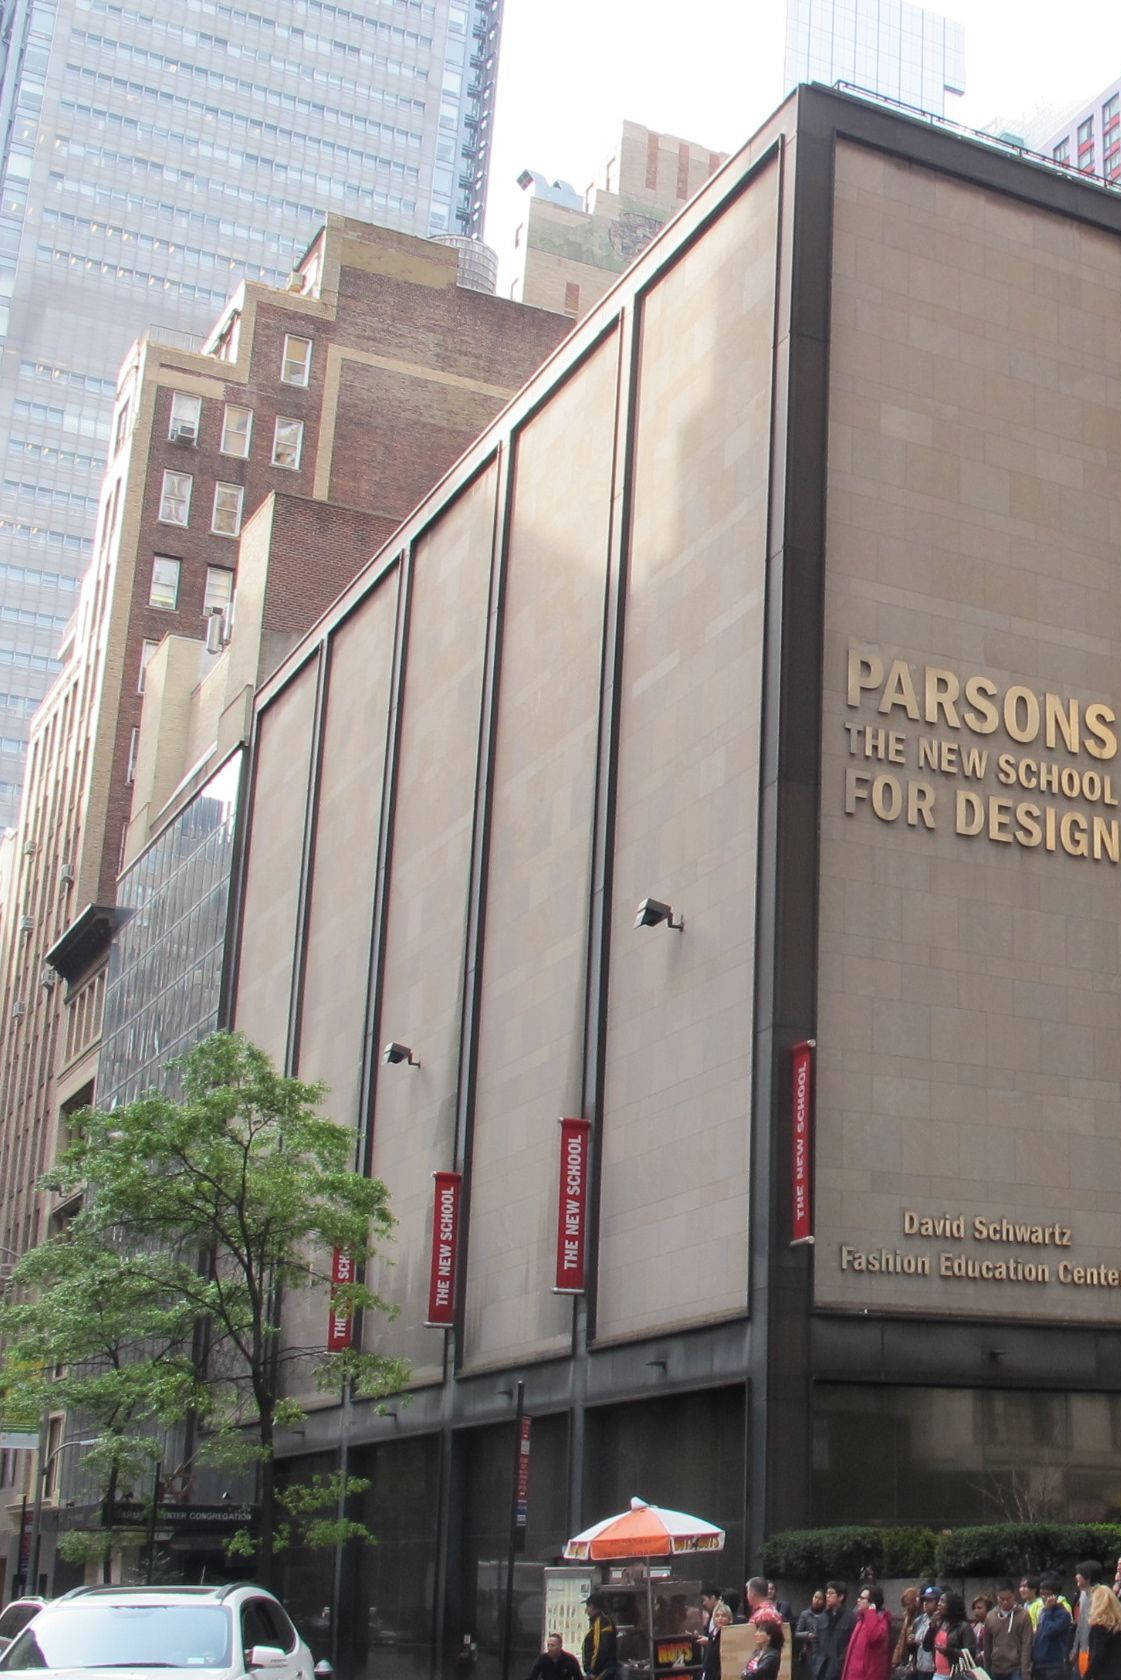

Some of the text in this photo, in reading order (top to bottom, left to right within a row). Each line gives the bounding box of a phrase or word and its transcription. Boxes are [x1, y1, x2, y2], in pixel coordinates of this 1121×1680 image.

[846, 648, 1118, 760] PARSONS
[844, 722, 1119, 806] THE NEW SCHOOL
[845, 767, 1120, 863] FOR DESIGN
[796, 1061, 807, 1221] THE NEW SCHOOL
[436, 1186, 455, 1306] THE NEW SCHOOL
[564, 1134, 582, 1270] THE NEW SCHOOL
[904, 1208, 1072, 1246] David Schwartz
[841, 1244, 930, 1275] Fashion
[939, 1253, 1049, 1283] Education
[189, 1512, 251, 1521] CONGREGATION
